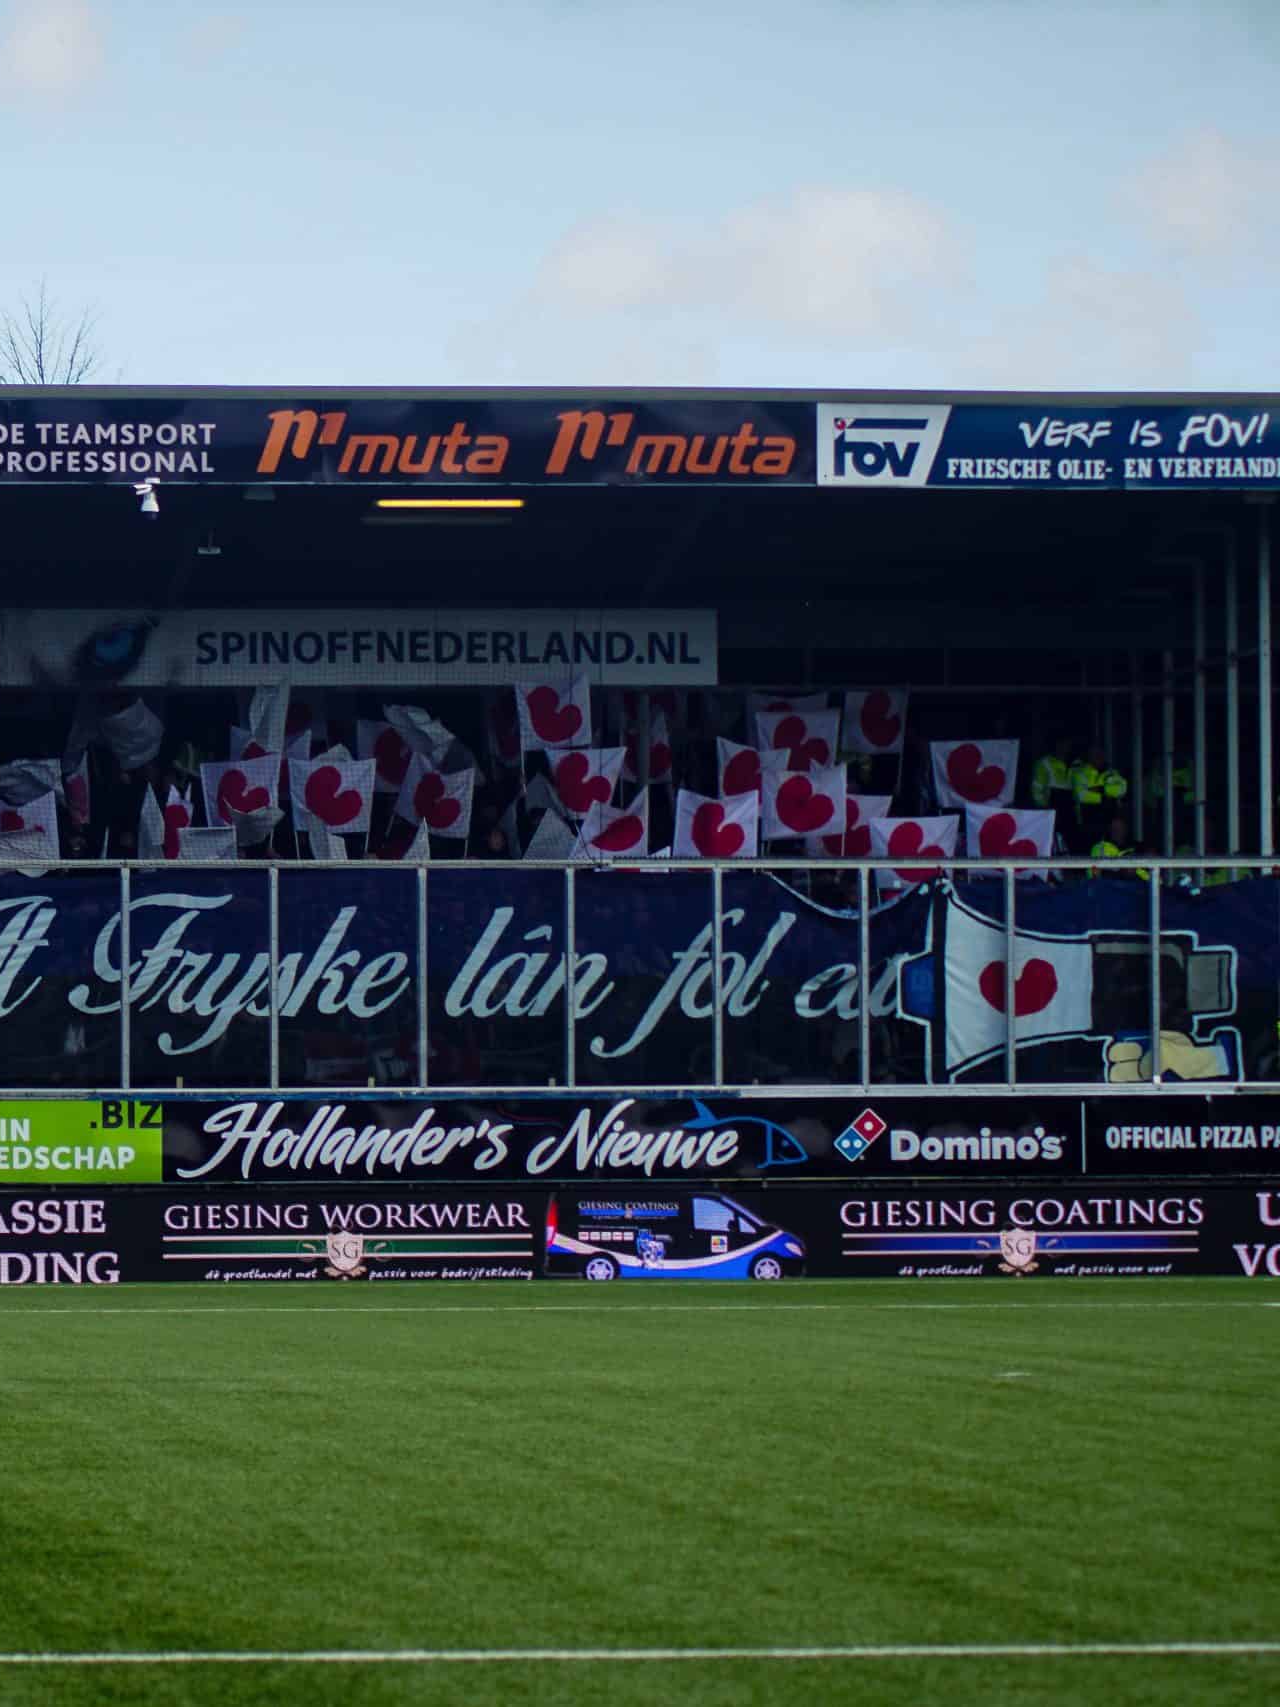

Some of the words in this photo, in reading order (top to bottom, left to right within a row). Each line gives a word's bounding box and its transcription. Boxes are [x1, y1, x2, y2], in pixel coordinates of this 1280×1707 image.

[36, 423, 216, 445] TEAMSPORT
[1019, 416, 1112, 448] VERF
[1129, 419, 1162, 447] IS
[339, 421, 509, 474] muta
[625, 422, 796, 475] muta
[947, 457, 1054, 480] FRIESCHE
[1058, 457, 1112, 480] OLIE-
[1124, 457, 1152, 478] EN
[1158, 457, 1280, 478] VERFHAND
[195, 631, 701, 665] SPINOFFNEDERLAND.NL
[69, 893, 411, 1056] Fryske
[444, 906, 614, 1018] lân
[590, 908, 796, 1058] fol
[90, 1100, 163, 1129] .BIZ
[0, 1118, 31, 1142] IN
[176, 1101, 513, 1179] Hollander's
[526, 1098, 738, 1177] Nieuwe
[890, 1127, 1063, 1161] Domino's
[1105, 1126, 1196, 1149] OFFICIAL
[1200, 1126, 1257, 1149] PIZZA
[163, 1203, 308, 1230] GIESING
[319, 1202, 531, 1230] WORKWEAR
[839, 1200, 996, 1227] GIESING
[1008, 1198, 1204, 1226] COATINGS
